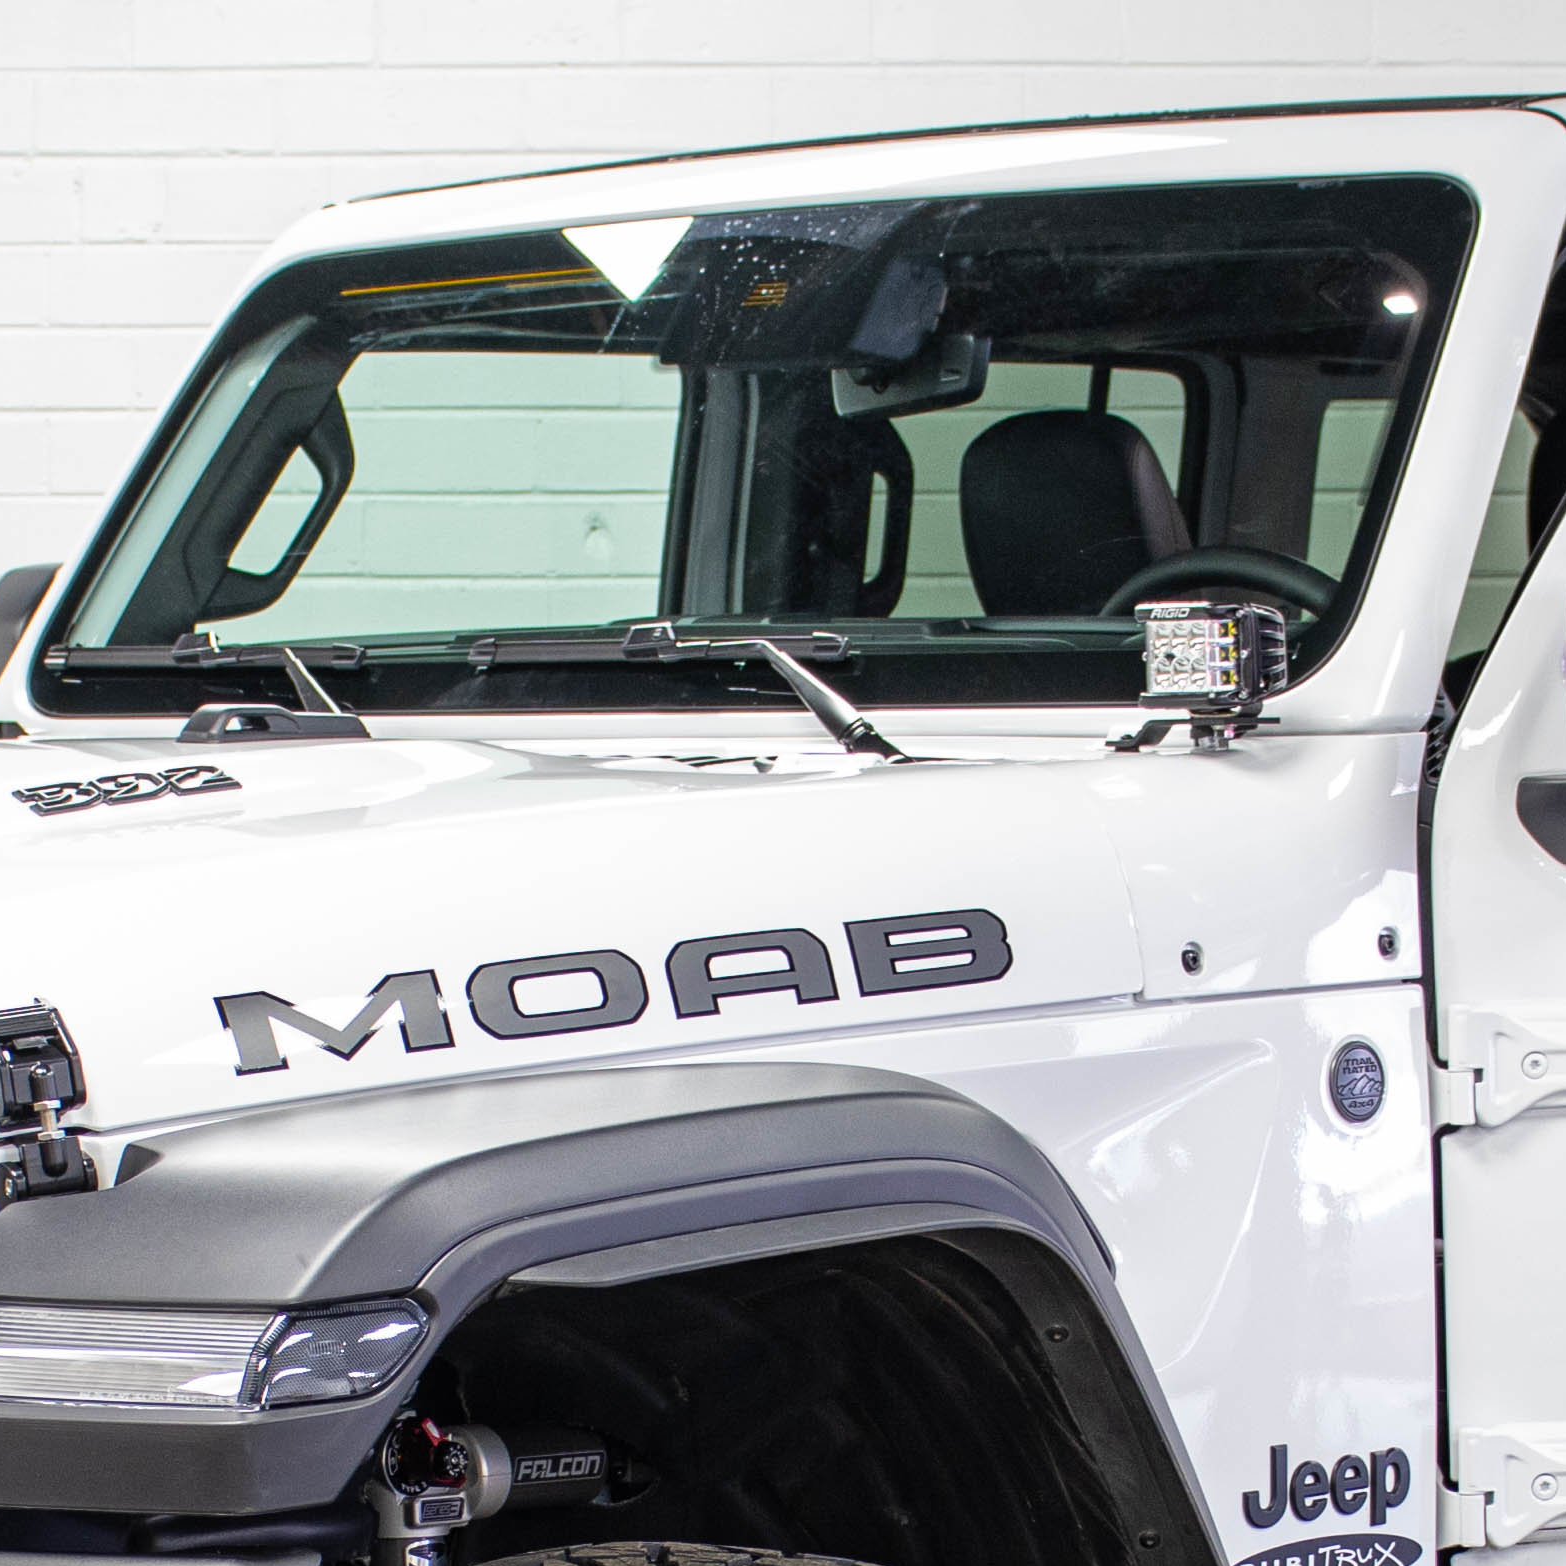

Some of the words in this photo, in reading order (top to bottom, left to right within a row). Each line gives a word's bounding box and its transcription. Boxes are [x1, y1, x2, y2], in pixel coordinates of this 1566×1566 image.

[1150, 607, 1190, 619] RIGID
[11, 765, 243, 817] 392
[213, 907, 1014, 1076] MOAB
[1342, 1064, 1378, 1075] RATED
[1344, 1057, 1375, 1067] TRAIL
[517, 1453, 602, 1482] FALCON
[1242, 1443, 1412, 1530] Jeep
